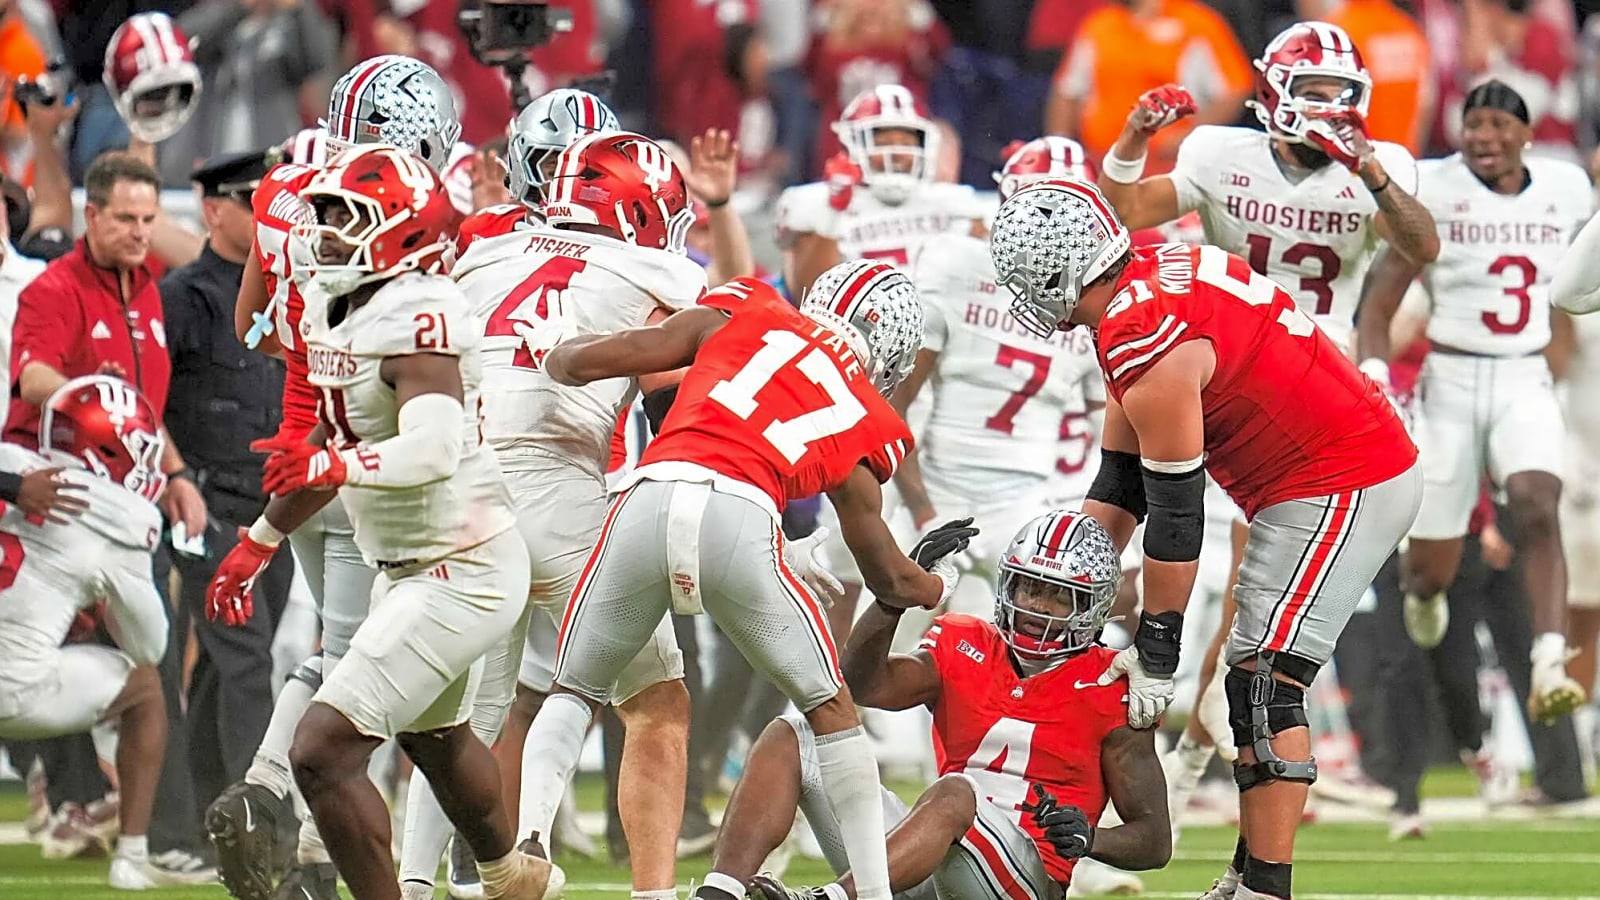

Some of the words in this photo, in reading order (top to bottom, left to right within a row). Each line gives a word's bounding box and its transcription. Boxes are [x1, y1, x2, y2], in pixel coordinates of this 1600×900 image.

[1226, 194, 1362, 235] HOOSIERS
[1449, 219, 1561, 245] HOOSIER
[523, 235, 592, 258] FISHER
[1245, 232, 1342, 316] 13
[483, 254, 588, 370] 4
[1105, 278, 1156, 320] 51
[1480, 255, 1538, 336] 3
[413, 312, 449, 350] 21
[809, 324, 863, 382] TATE
[706, 329, 869, 467] 17
[985, 342, 1053, 438] 7
[1031, 555, 1045, 567] OHIO
[1045, 560, 1064, 571] STATE
[962, 716, 1036, 827] 4
